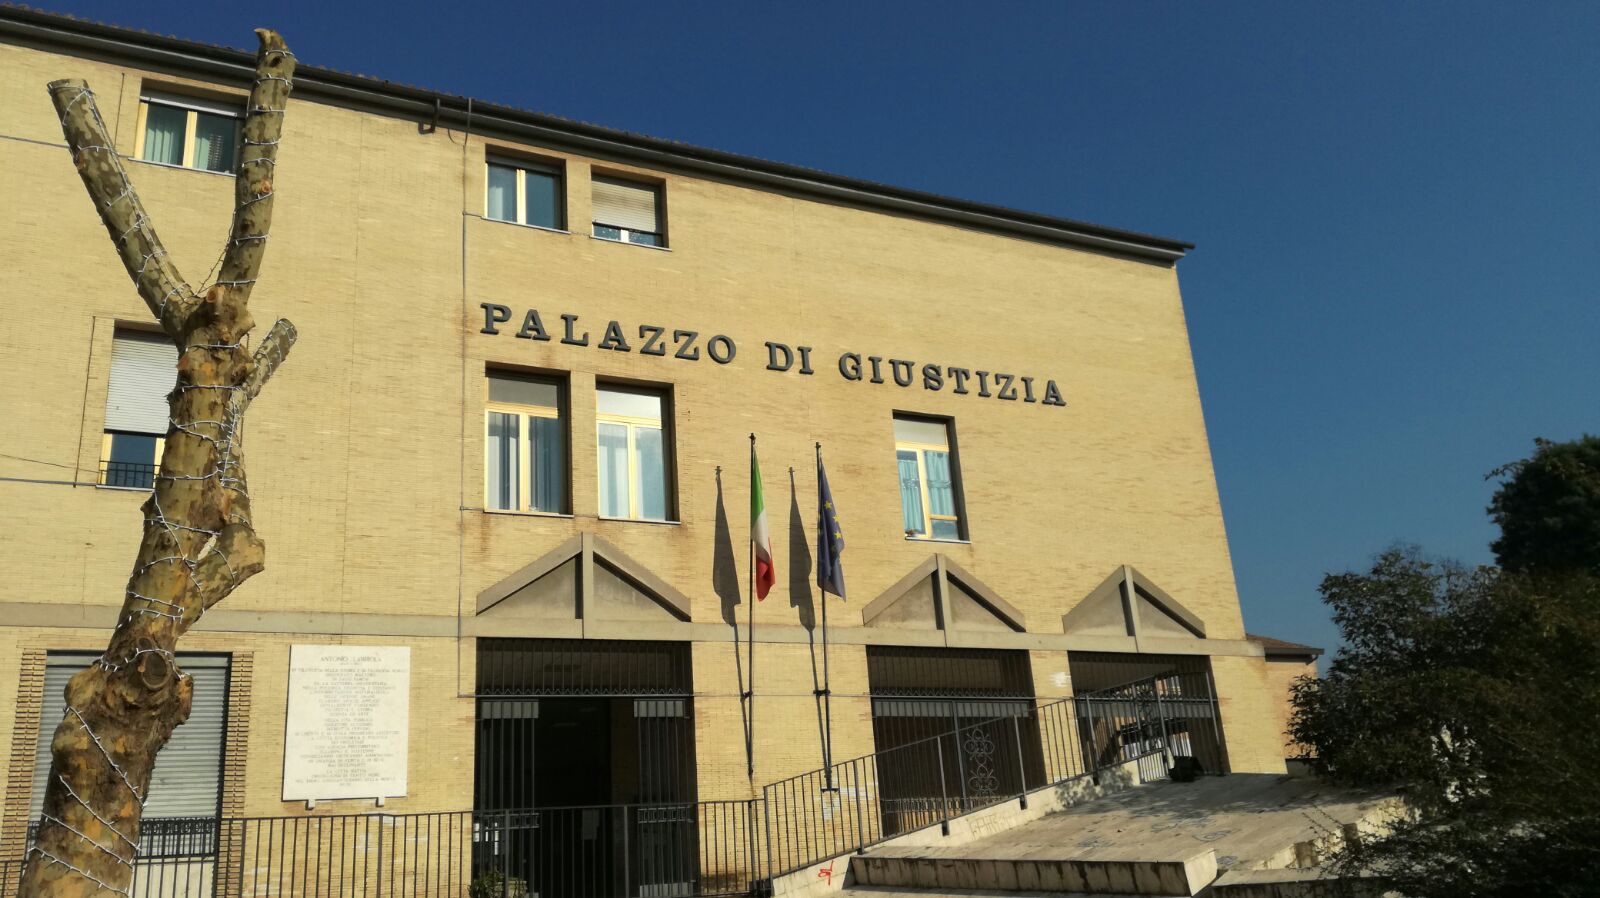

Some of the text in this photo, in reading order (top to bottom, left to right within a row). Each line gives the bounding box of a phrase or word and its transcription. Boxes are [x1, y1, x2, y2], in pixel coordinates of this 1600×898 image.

[480, 303, 1066, 407] PALAZZO DI GIUSTIZIA
